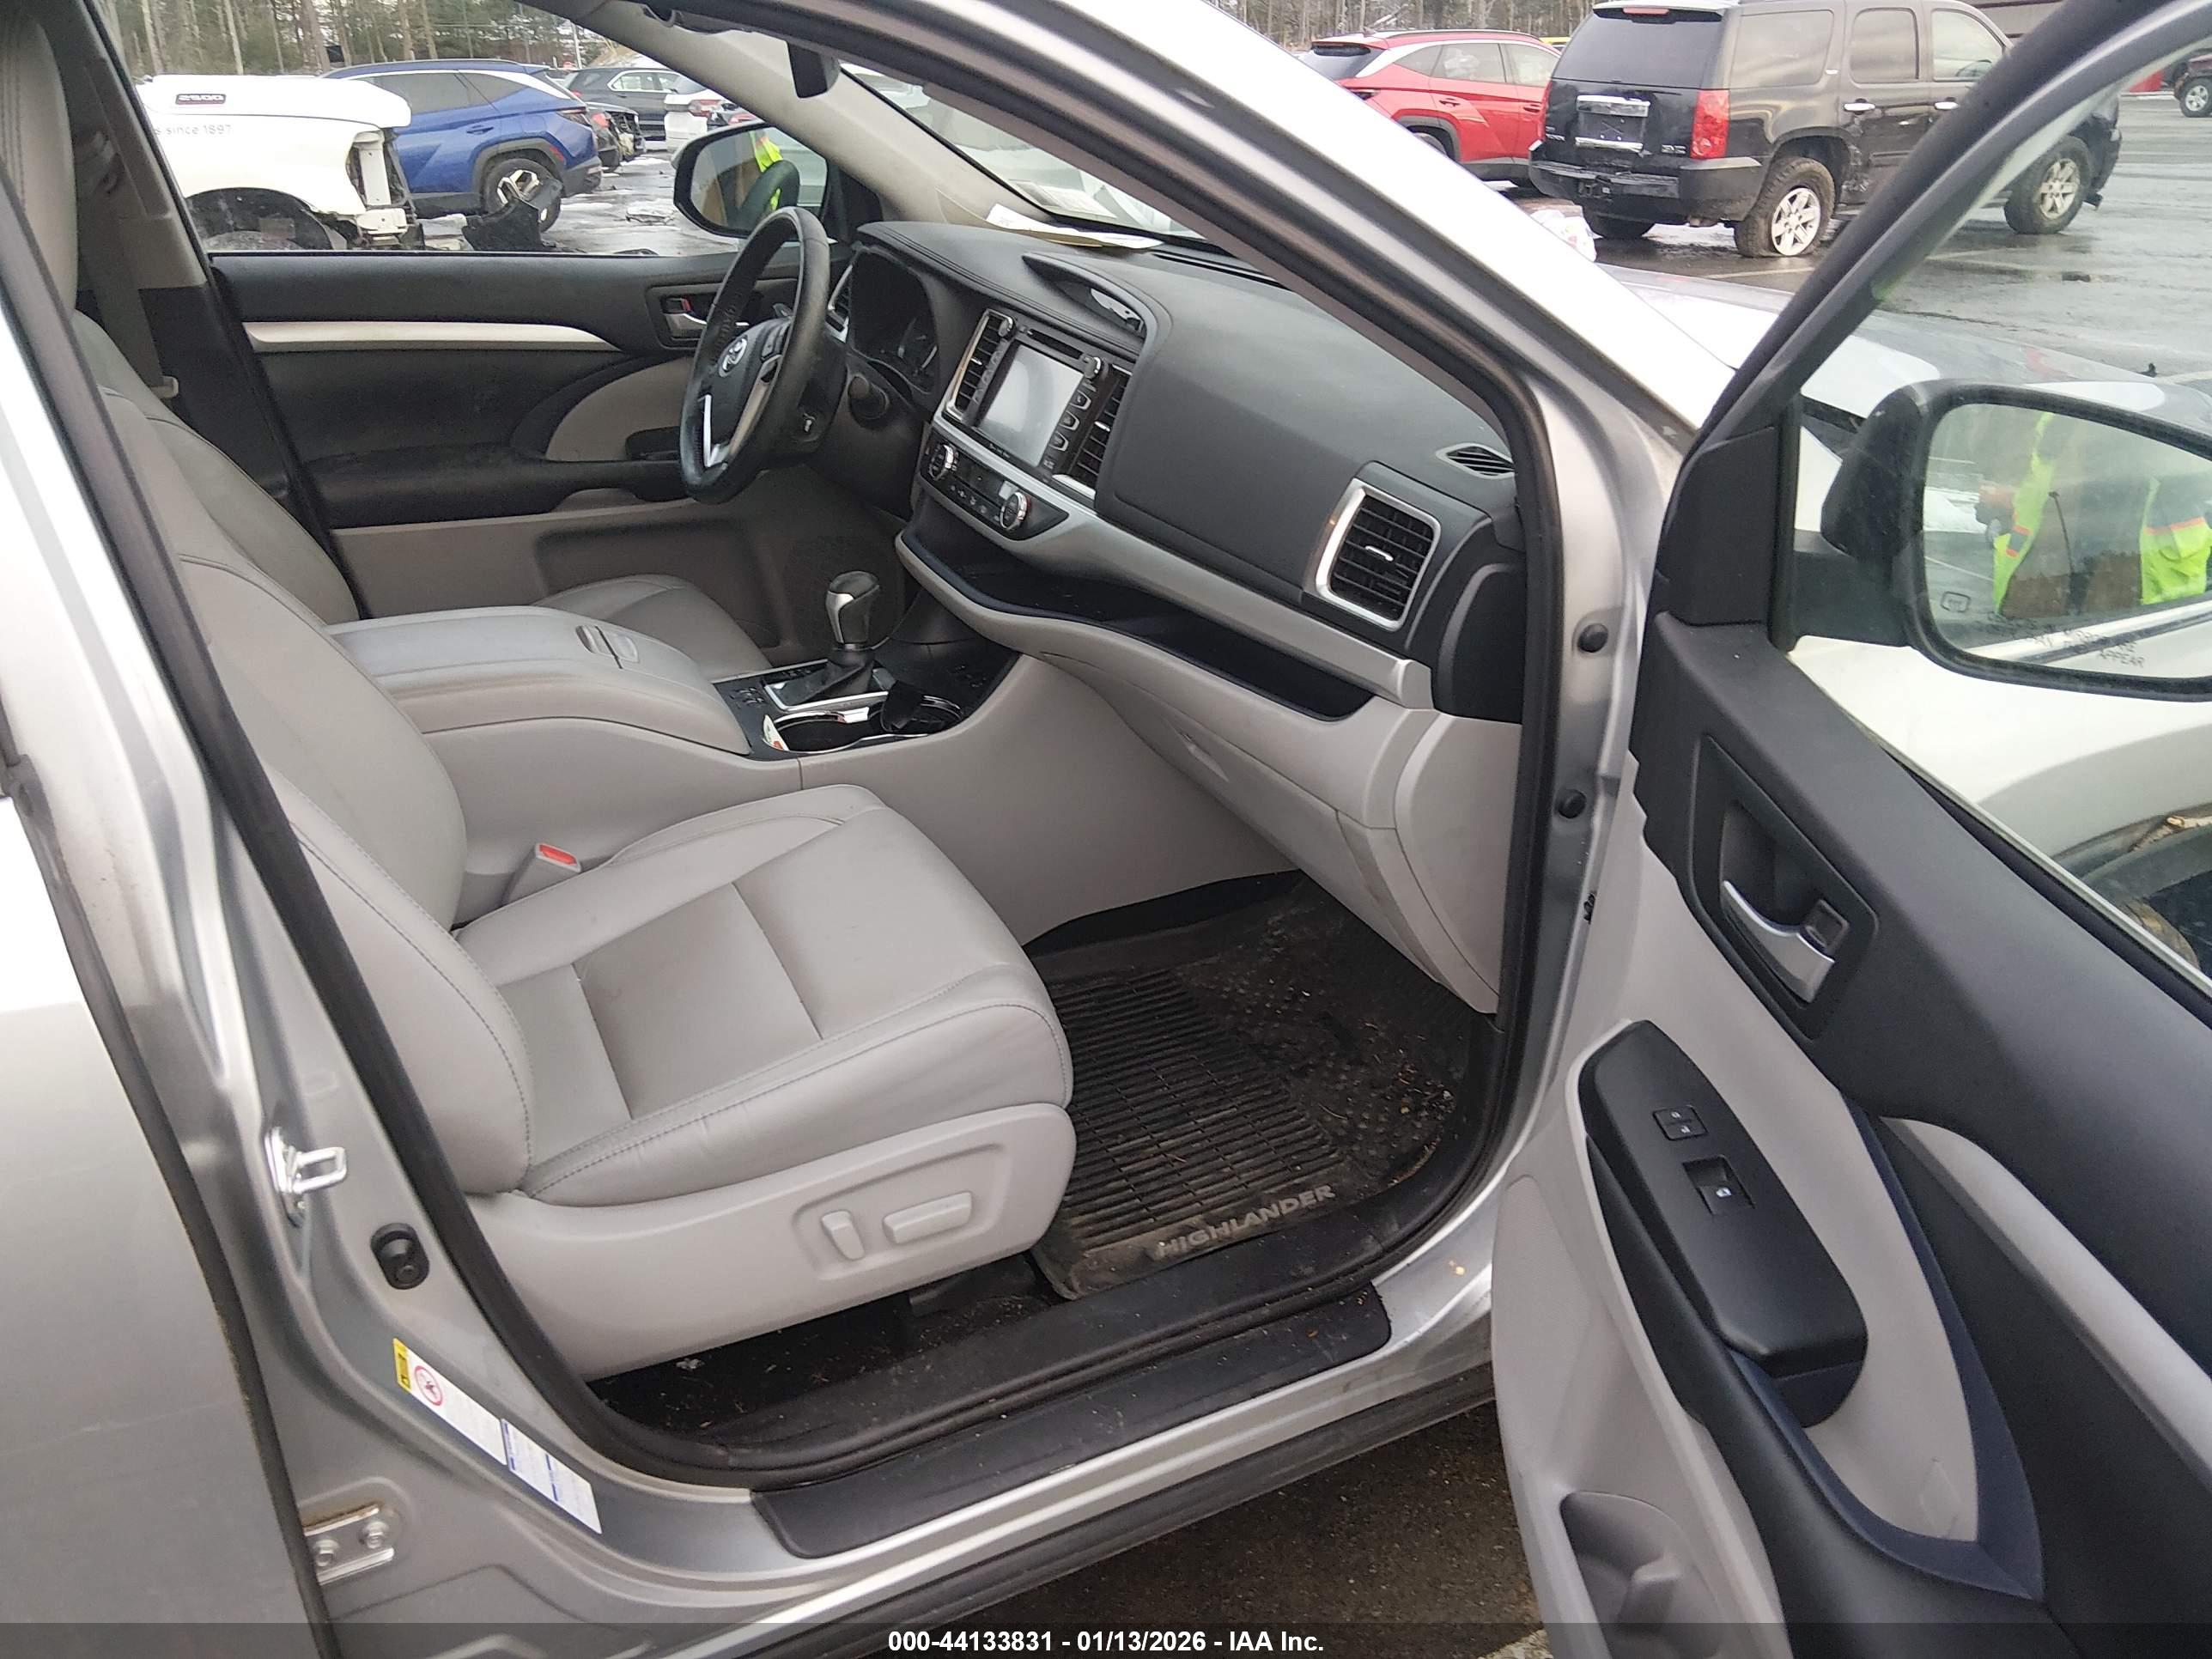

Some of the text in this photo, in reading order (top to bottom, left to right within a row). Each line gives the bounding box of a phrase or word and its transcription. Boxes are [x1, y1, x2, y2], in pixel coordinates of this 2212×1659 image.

[166, 126, 199, 135] since
[203, 124, 232, 135] 1897
[1153, 1184, 1336, 1261] HIGHLANDER
